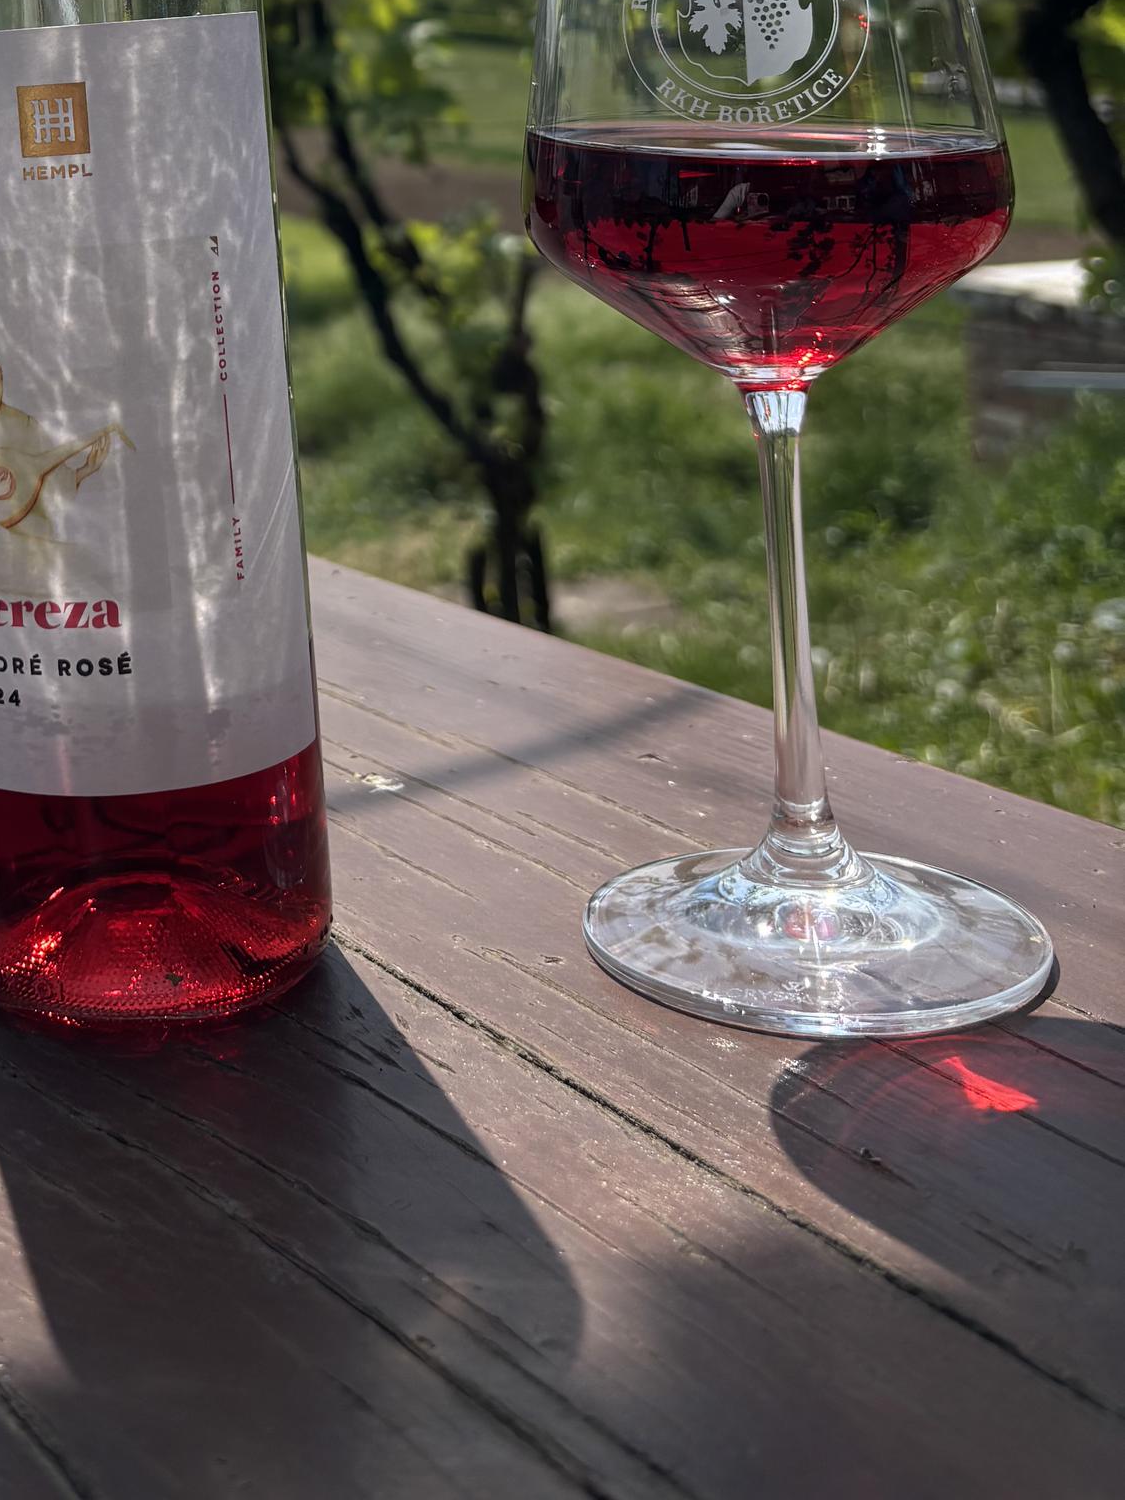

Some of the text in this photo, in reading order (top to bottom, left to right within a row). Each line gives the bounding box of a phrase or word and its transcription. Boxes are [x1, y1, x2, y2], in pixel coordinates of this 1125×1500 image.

[655, 67, 845, 126] RKH BOŘETICE
[22, 163, 93, 181] HEMPL
[211, 271, 245, 581] FAMILY COLLECTION
[58, 651, 133, 677] ROSÉ
